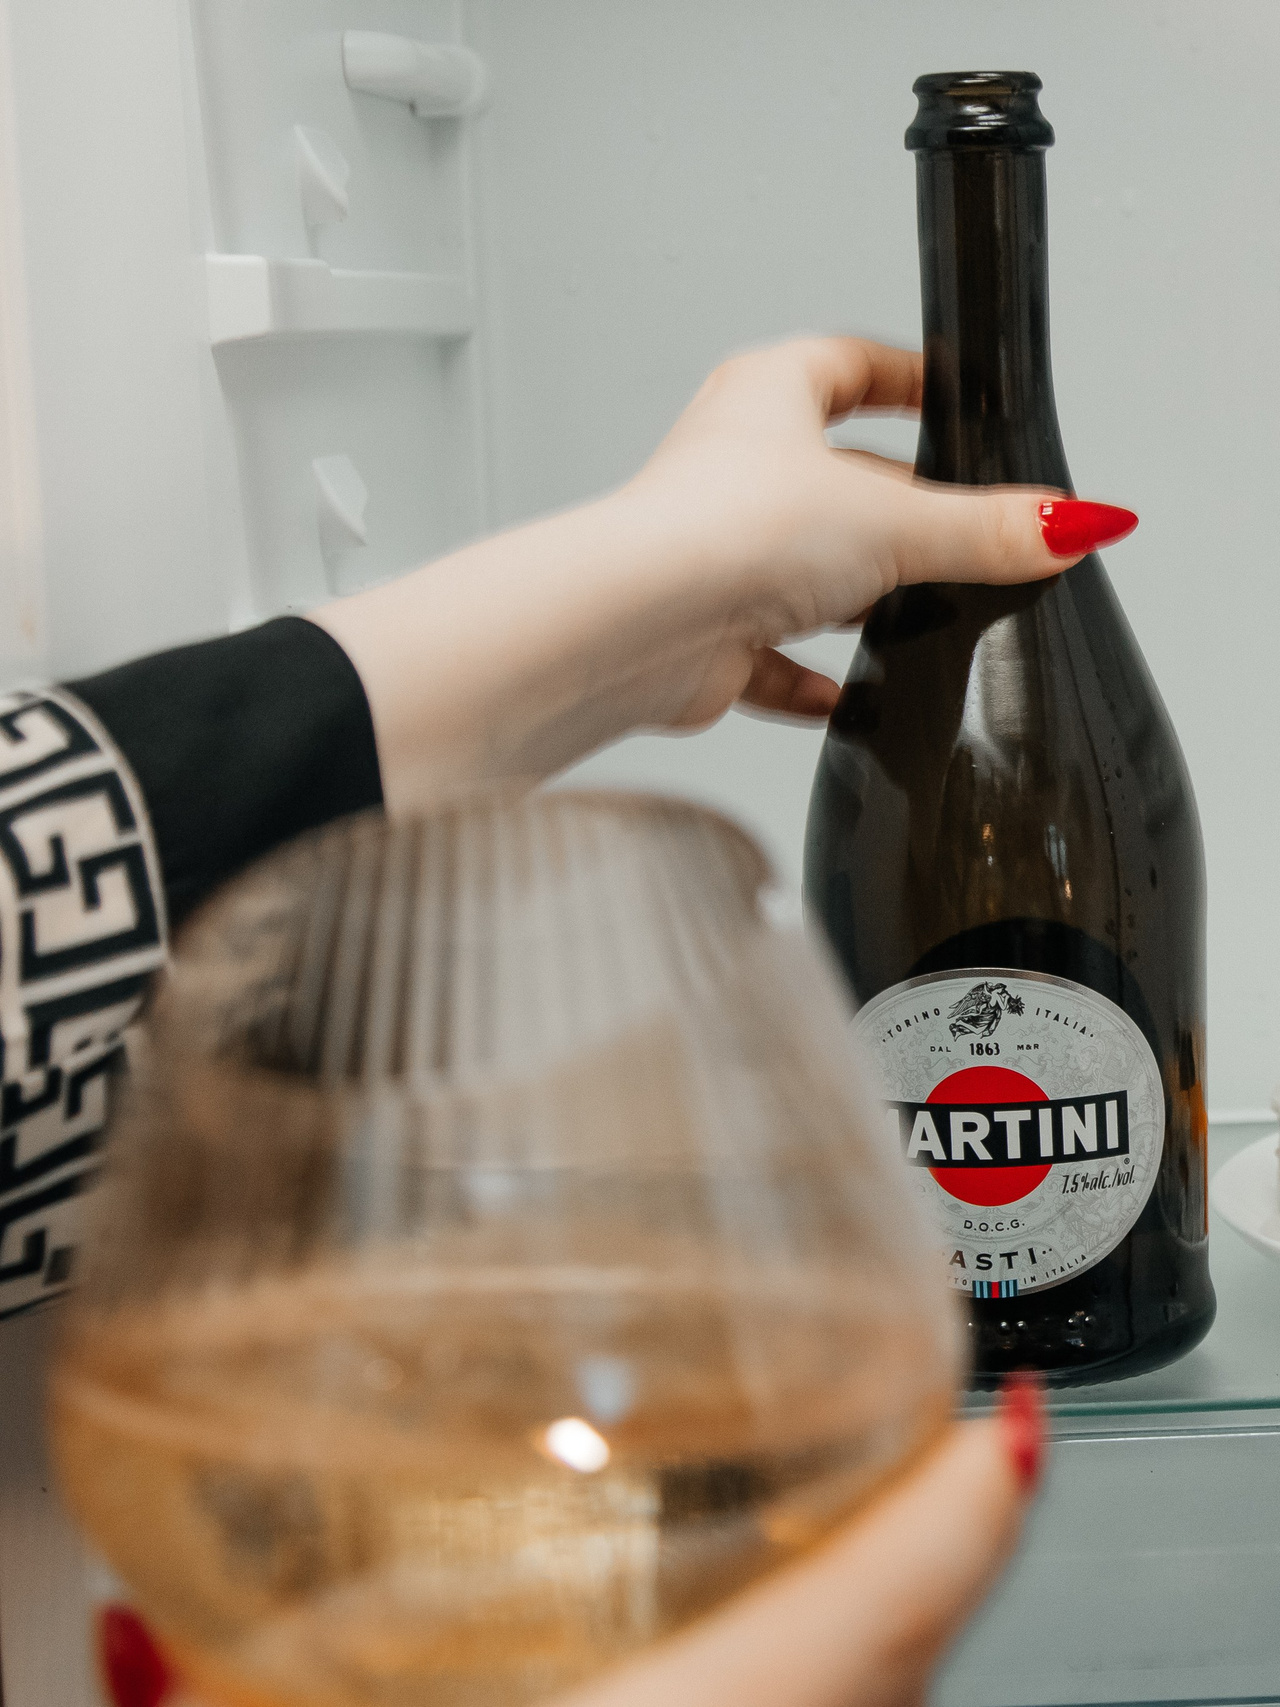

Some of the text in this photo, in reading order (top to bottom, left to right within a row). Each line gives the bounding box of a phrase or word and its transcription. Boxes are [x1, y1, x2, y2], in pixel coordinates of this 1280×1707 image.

[886, 1007, 1087, 1038] TORINO ITALIA
[969, 1042, 1000, 1056] 1863
[1016, 1043, 1040, 1051] M&R
[963, 1219, 1026, 1232] D.O.C.G.
[1023, 1254, 1087, 1286] IN ITALIA
